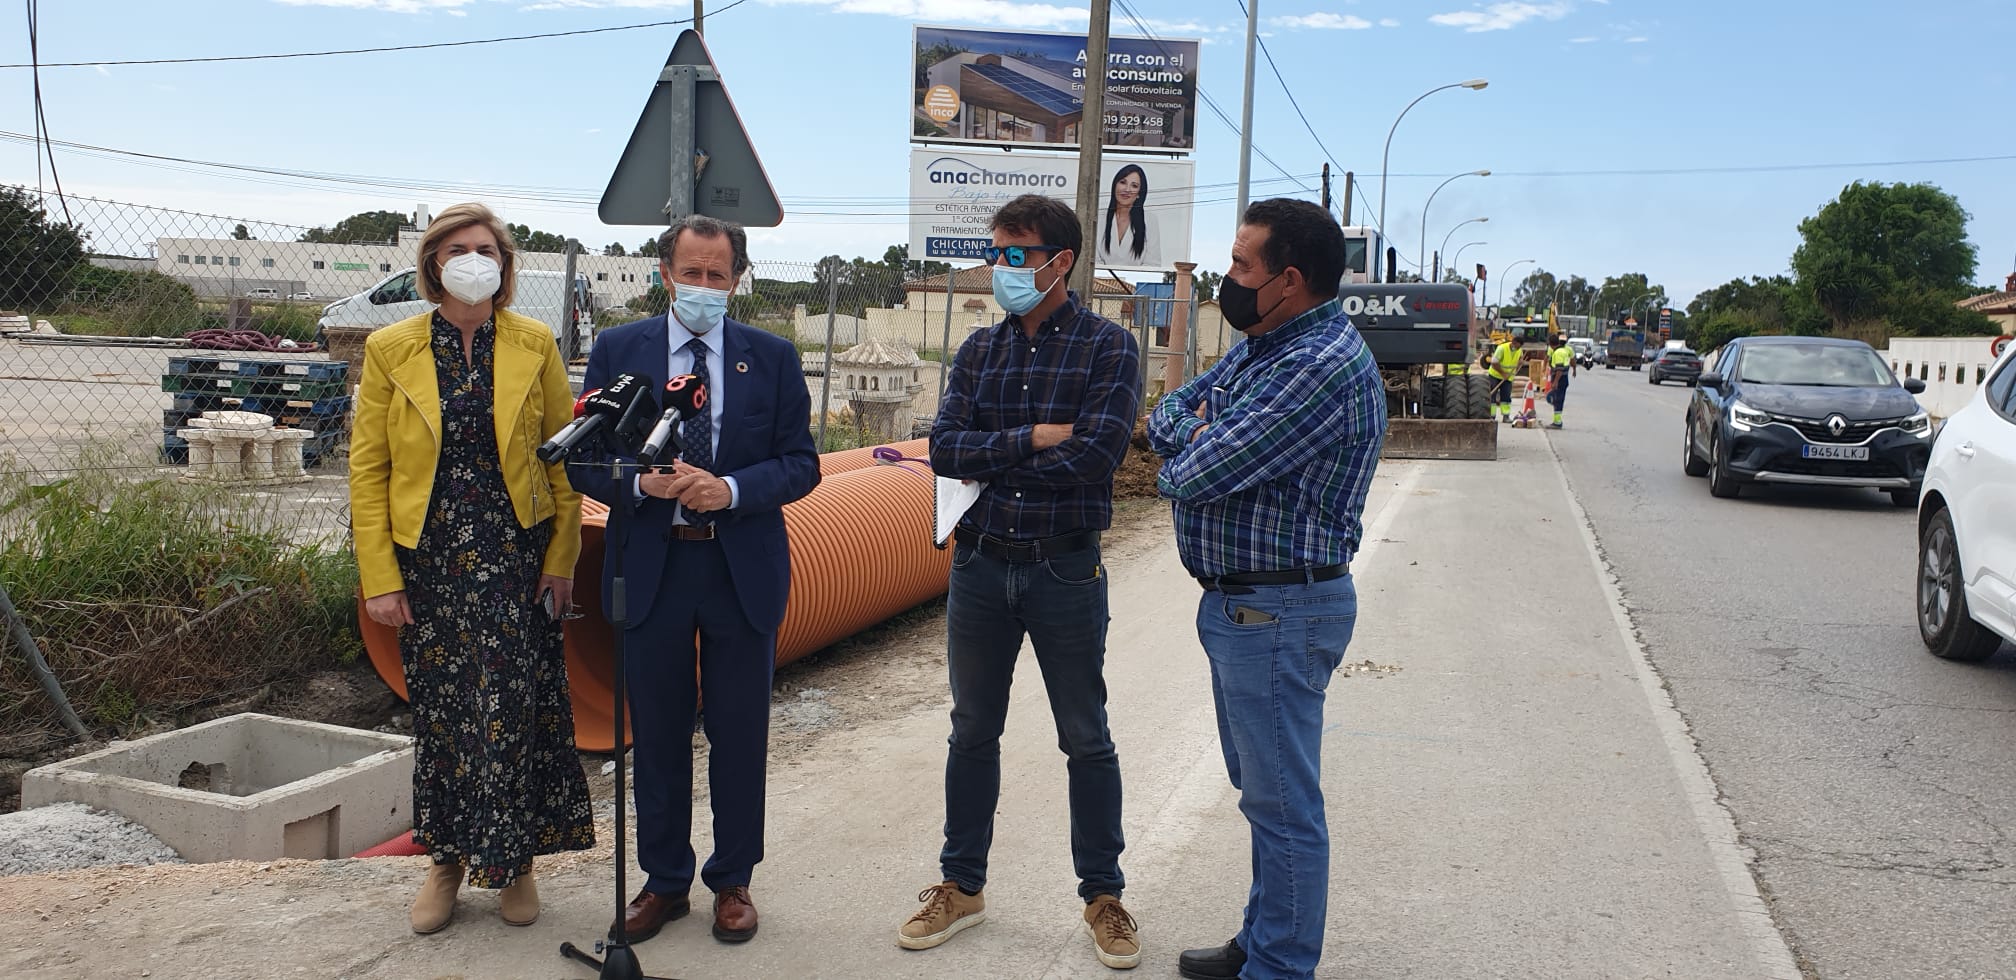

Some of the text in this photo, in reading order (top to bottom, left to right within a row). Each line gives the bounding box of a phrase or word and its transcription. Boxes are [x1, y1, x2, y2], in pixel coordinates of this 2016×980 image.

[1075, 49, 1184, 67] Arra con el
[1072, 66, 1184, 82] aconsumo
[1108, 84, 1183, 96] solar fotovoltaica
[1106, 100, 1149, 108] COMUNIDADES
[1120, 115, 1140, 126] 929
[1143, 117, 1164, 127] 458
[929, 168, 1067, 188] anachamorro
[961, 215, 990, 224] CONSU
[932, 239, 987, 249] CHICLANA
[1342, 295, 1408, 316] O&K
[1811, 446, 1866, 459] 9454 LKJ
